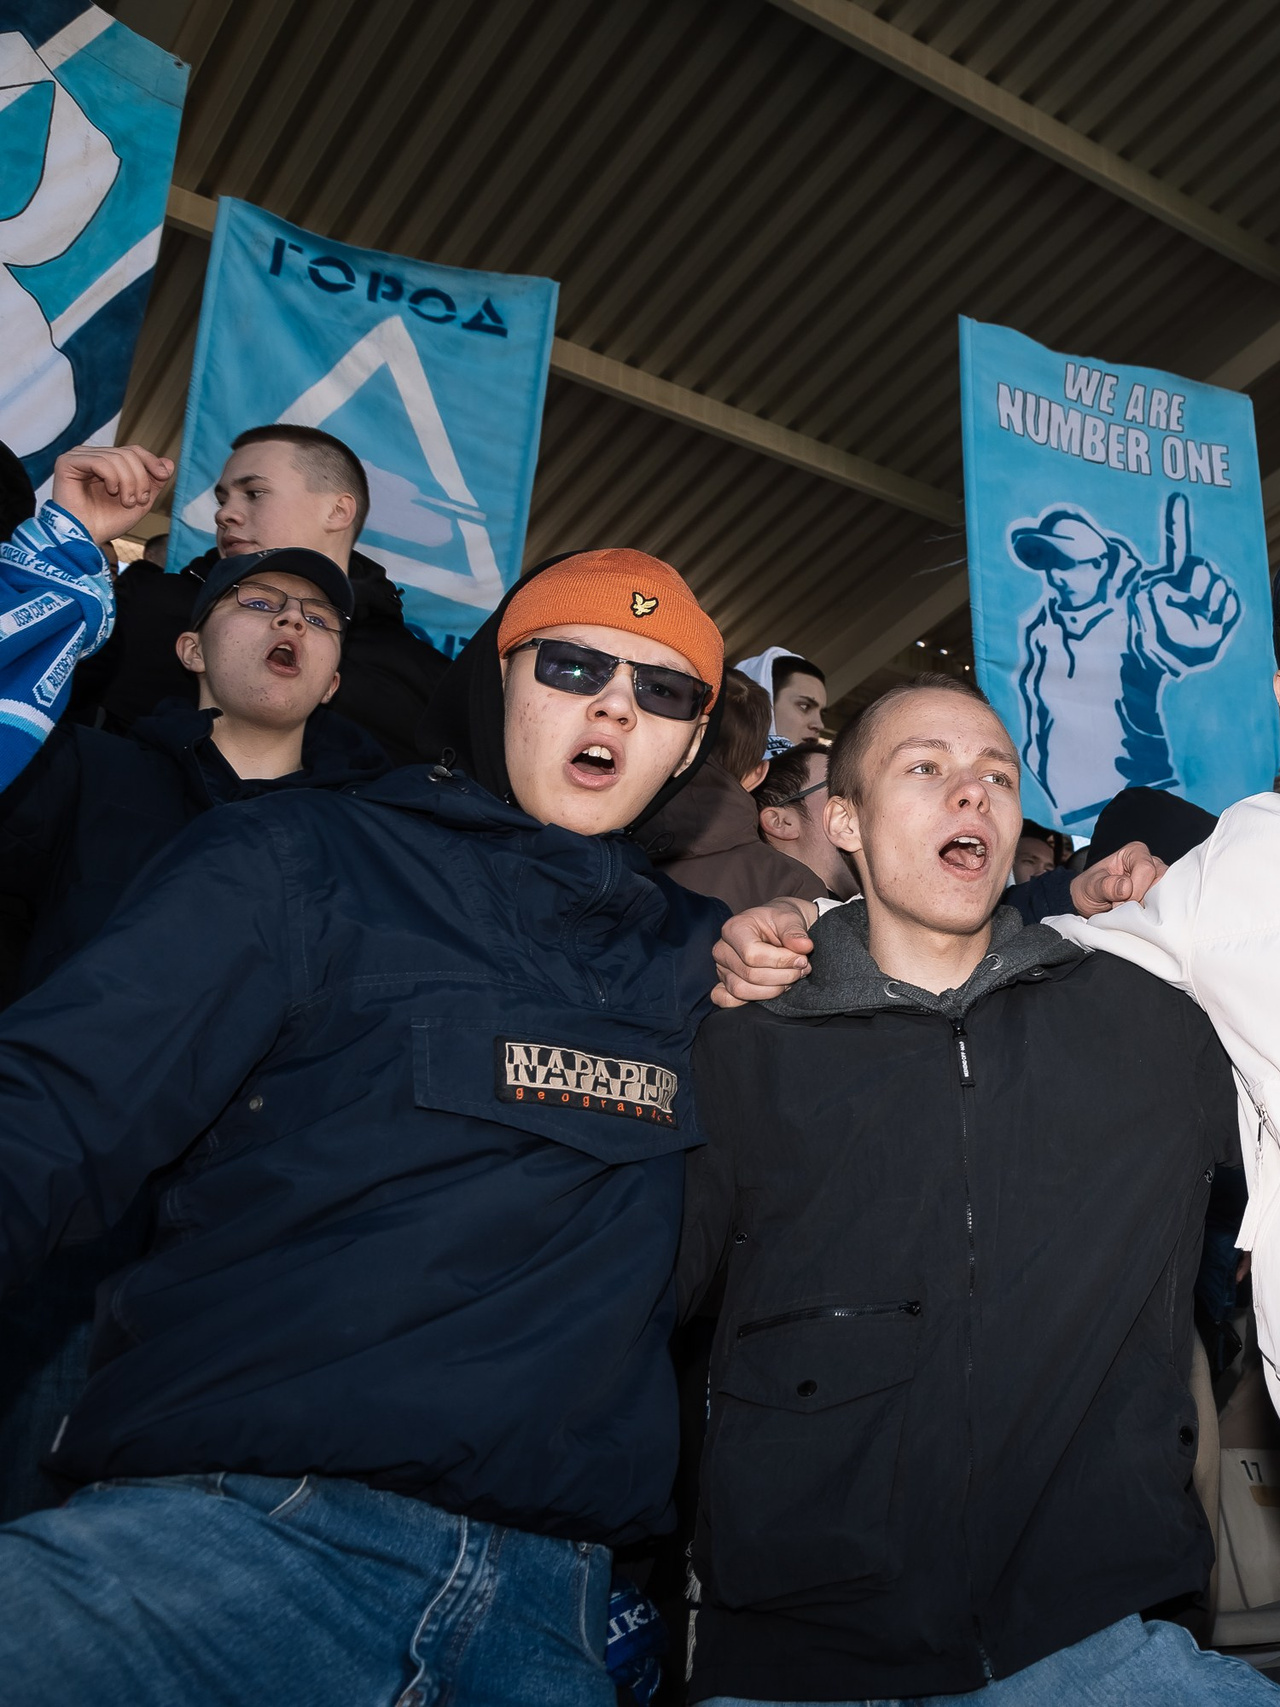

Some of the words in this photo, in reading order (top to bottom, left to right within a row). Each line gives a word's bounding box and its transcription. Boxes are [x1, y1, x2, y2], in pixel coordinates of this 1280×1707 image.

[268, 235, 509, 338] ГОРОД
[996, 382, 1152, 477] NUMBER
[1160, 435, 1232, 488] ONE
[1063, 361, 1118, 416] WE
[1123, 384, 1186, 433] ARE
[1240, 1459, 1263, 1483] 17
